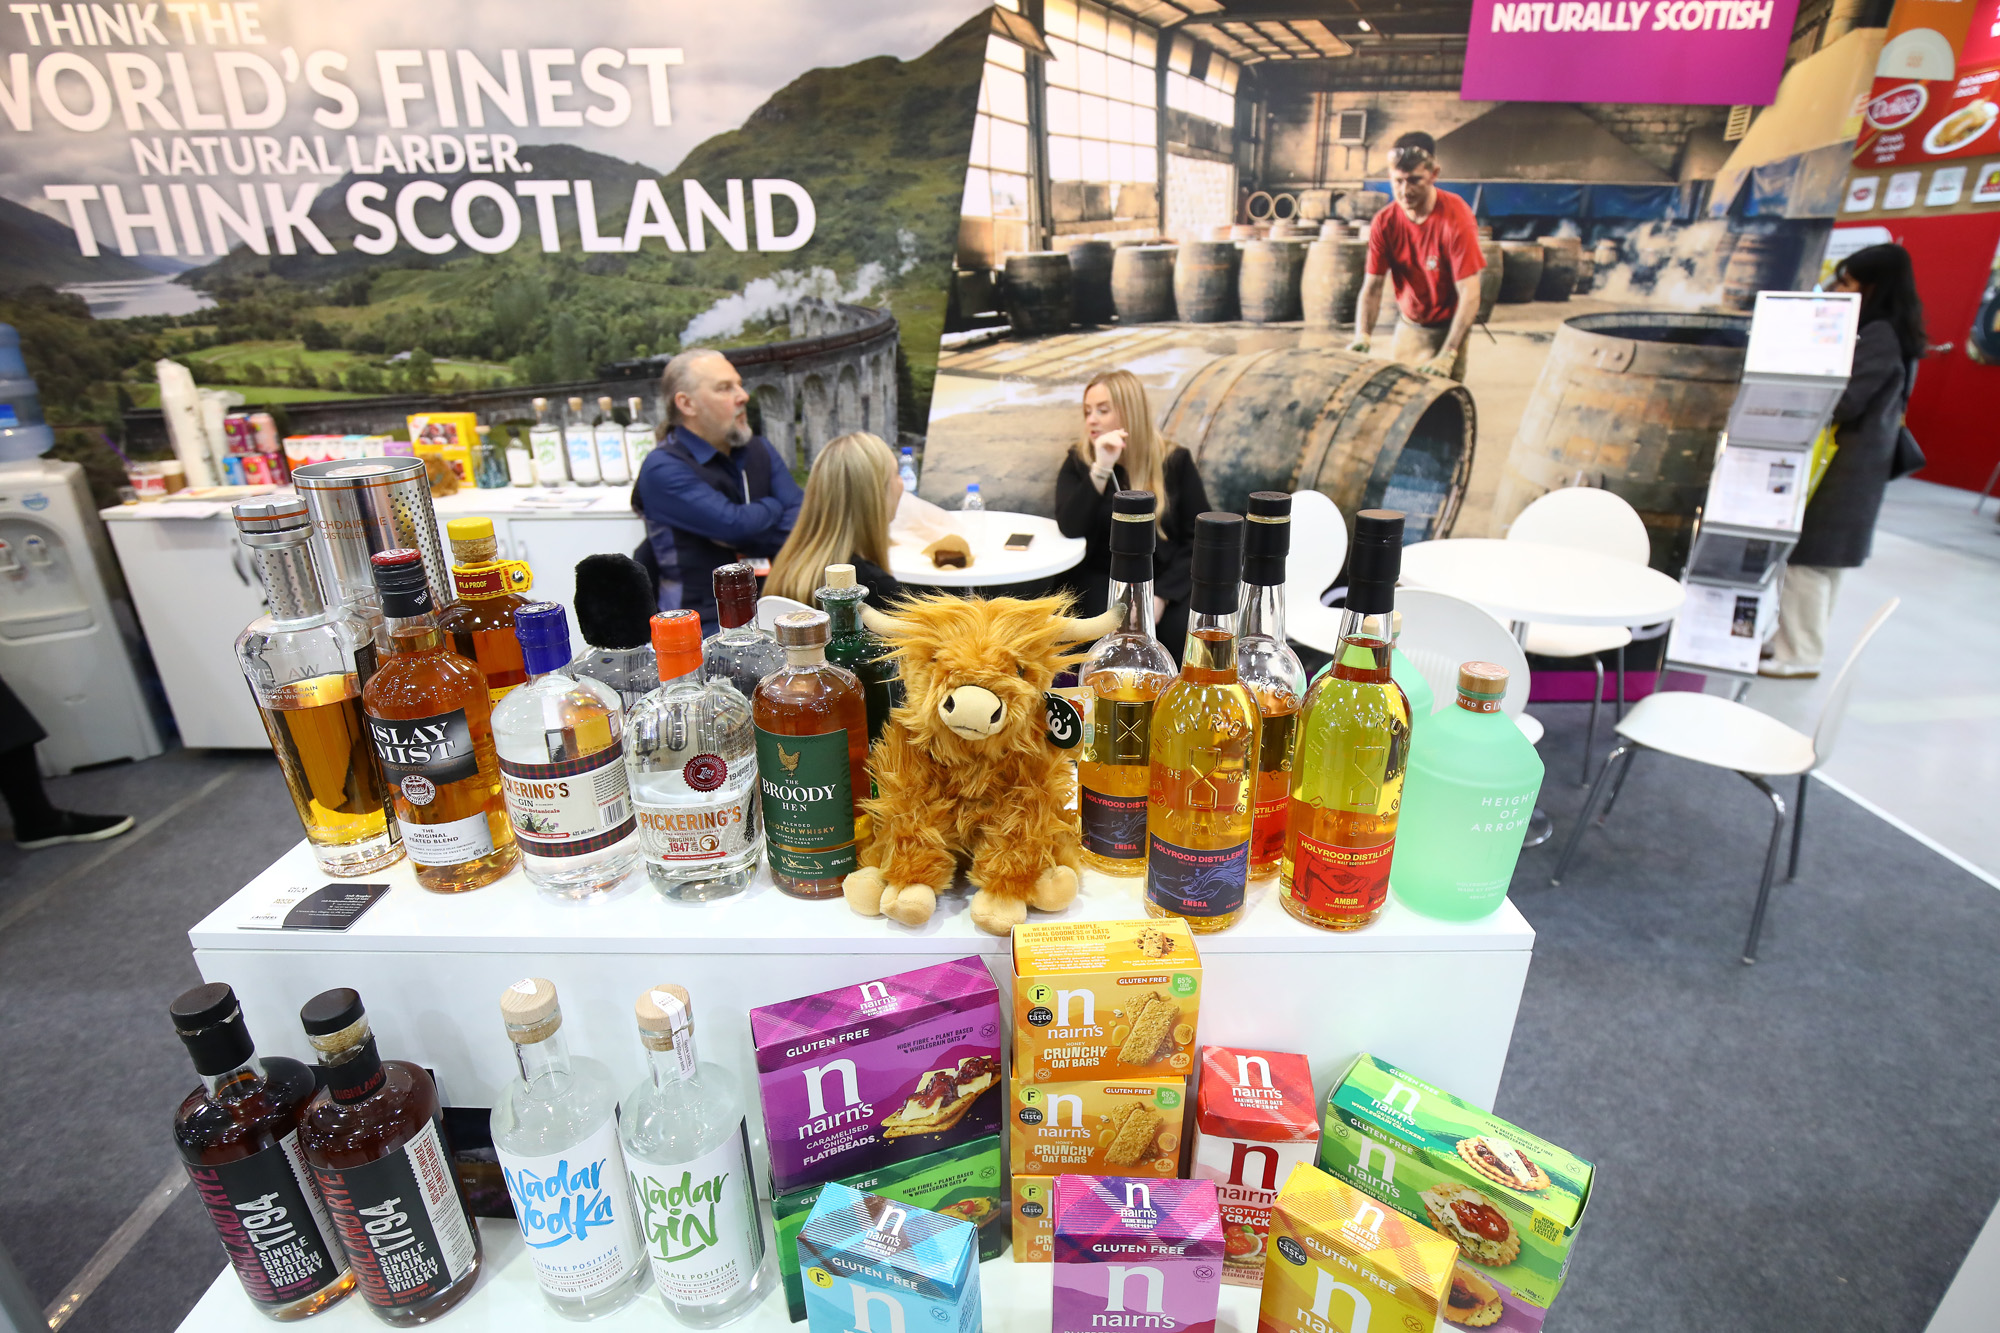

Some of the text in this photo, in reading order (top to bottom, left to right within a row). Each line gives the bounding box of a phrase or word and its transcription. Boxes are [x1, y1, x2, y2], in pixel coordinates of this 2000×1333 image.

[10, 2, 267, 46] THINK THE
[1491, 1, 1772, 33] NATURALLY SCOTTISH
[377, 47, 684, 129] FINEST
[130, 133, 533, 177] NATURAL LARDER.
[44, 179, 817, 258] THINK SCOTLAND
[312, 516, 387, 530] NCHDAIRNIE
[370, 721, 448, 746] ISLAY
[376, 740, 457, 764] MIST
[762, 777, 836, 803] BROODY
[1086, 793, 1125, 809] HOLYROOD
[1481, 791, 1535, 807] HEIGHT
[518, 799, 534, 808] GIN
[782, 803, 807, 812] HEN
[1499, 809, 1518, 819] OF
[640, 806, 742, 831] PICKERING'S
[799, 826, 835, 835] WHISKY
[1471, 817, 1530, 832] ARROWS
[433, 835, 459, 844] BLEND
[669, 843, 690, 853] 1947
[1301, 840, 1394, 861] HOLYROOD DISTILLERY
[1153, 842, 1244, 863] HOLYROOD DISTILLERY
[1334, 897, 1359, 905] AMBIR
[858, 981, 891, 1001] n
[859, 995, 897, 1010] nairn's
[1036, 989, 1045, 1000] F
[1028, 1013, 1052, 1022] taste
[1056, 989, 1096, 1027] n
[786, 1028, 870, 1058] GLUTEN FREE
[897, 1026, 974, 1051] HIGH FIBRE PLANT BASED
[1047, 1025, 1103, 1039] nairn's
[909, 1035, 961, 1054] WHOLEGRAIN OATS
[1043, 1046, 1108, 1060] CRUNCHY
[1051, 1057, 1100, 1069] OAT BARS
[1235, 1054, 1274, 1088] n
[801, 1058, 862, 1120] n
[1232, 1087, 1283, 1099] nairn's
[1389, 1068, 1440, 1095] GLUTEN FREE
[1028, 1092, 1035, 1101] F
[1381, 1080, 1421, 1115] n
[798, 1102, 874, 1141] nairn's
[1020, 1113, 1043, 1121] taste
[1046, 1093, 1083, 1127] n
[1351, 1101, 1426, 1142] WHOLEGRAIN CRACKERS
[1371, 1097, 1417, 1127] nairn's
[1376, 1110, 1403, 1127] ORIGINAL
[806, 1124, 869, 1149] CARAMELISED
[823, 1134, 853, 1149] ONION
[1038, 1127, 1091, 1138] nairn's
[1350, 1118, 1414, 1155] GLUTEN FREE
[803, 1135, 876, 1166] FLATBREADS
[1034, 1144, 1095, 1157] CRUNCHY
[1042, 1155, 1087, 1163] OAT BARS
[1357, 1134, 1398, 1184] n
[1227, 1142, 1279, 1190] n
[903, 1171, 974, 1195] HIGH FIBRE PLANT BASED
[914, 1180, 962, 1197] WHOLEGRAIN OATS
[1328, 1167, 1418, 1219] WHOLEGRAIN CRACKERS
[1347, 1163, 1401, 1200] nairn's
[1125, 1183, 1151, 1208] n
[235, 1192, 297, 1251] 1794
[875, 1205, 907, 1236] n
[1120, 1208, 1157, 1218] nairn's
[1222, 1206, 1271, 1218] SCOTTISH
[1352, 1200, 1386, 1233] n
[1541, 1216, 1555, 1226] NOW
[188, 1166, 277, 1301] HIGHLAND RYE
[314, 1170, 393, 1306] HIGHLAND RYE
[359, 1197, 415, 1256] 1794
[865, 1229, 901, 1246] nairn's
[1342, 1221, 1381, 1245] nairn's
[1534, 1218, 1560, 1235] CRISPIER
[1534, 1222, 1558, 1239] LIGHTER
[1534, 1228, 1556, 1242] TASTIER
[259, 1236, 308, 1262] SINGLE
[263, 1249, 305, 1271] GRAIN
[379, 1242, 427, 1267] SINGLE
[572, 1244, 619, 1271] POSITIVE
[1092, 1244, 1185, 1255] GLUTEN FREE
[1278, 1240, 1306, 1263] taste
[269, 1251, 320, 1280] SCOTCH
[271, 1258, 323, 1288] WHISKY
[382, 1255, 423, 1277] GRAIN
[386, 1256, 436, 1284] SCOTCH
[690, 1258, 737, 1281] POSITIVE
[816, 1271, 825, 1283] F
[832, 1257, 918, 1291] GLUTEN FREE
[1305, 1236, 1398, 1295] GLUTEN FREE
[389, 1264, 439, 1293] WHISKY
[1106, 1266, 1164, 1313] n
[1311, 1266, 1373, 1333] n
[1092, 1314, 1176, 1328] nairn's
